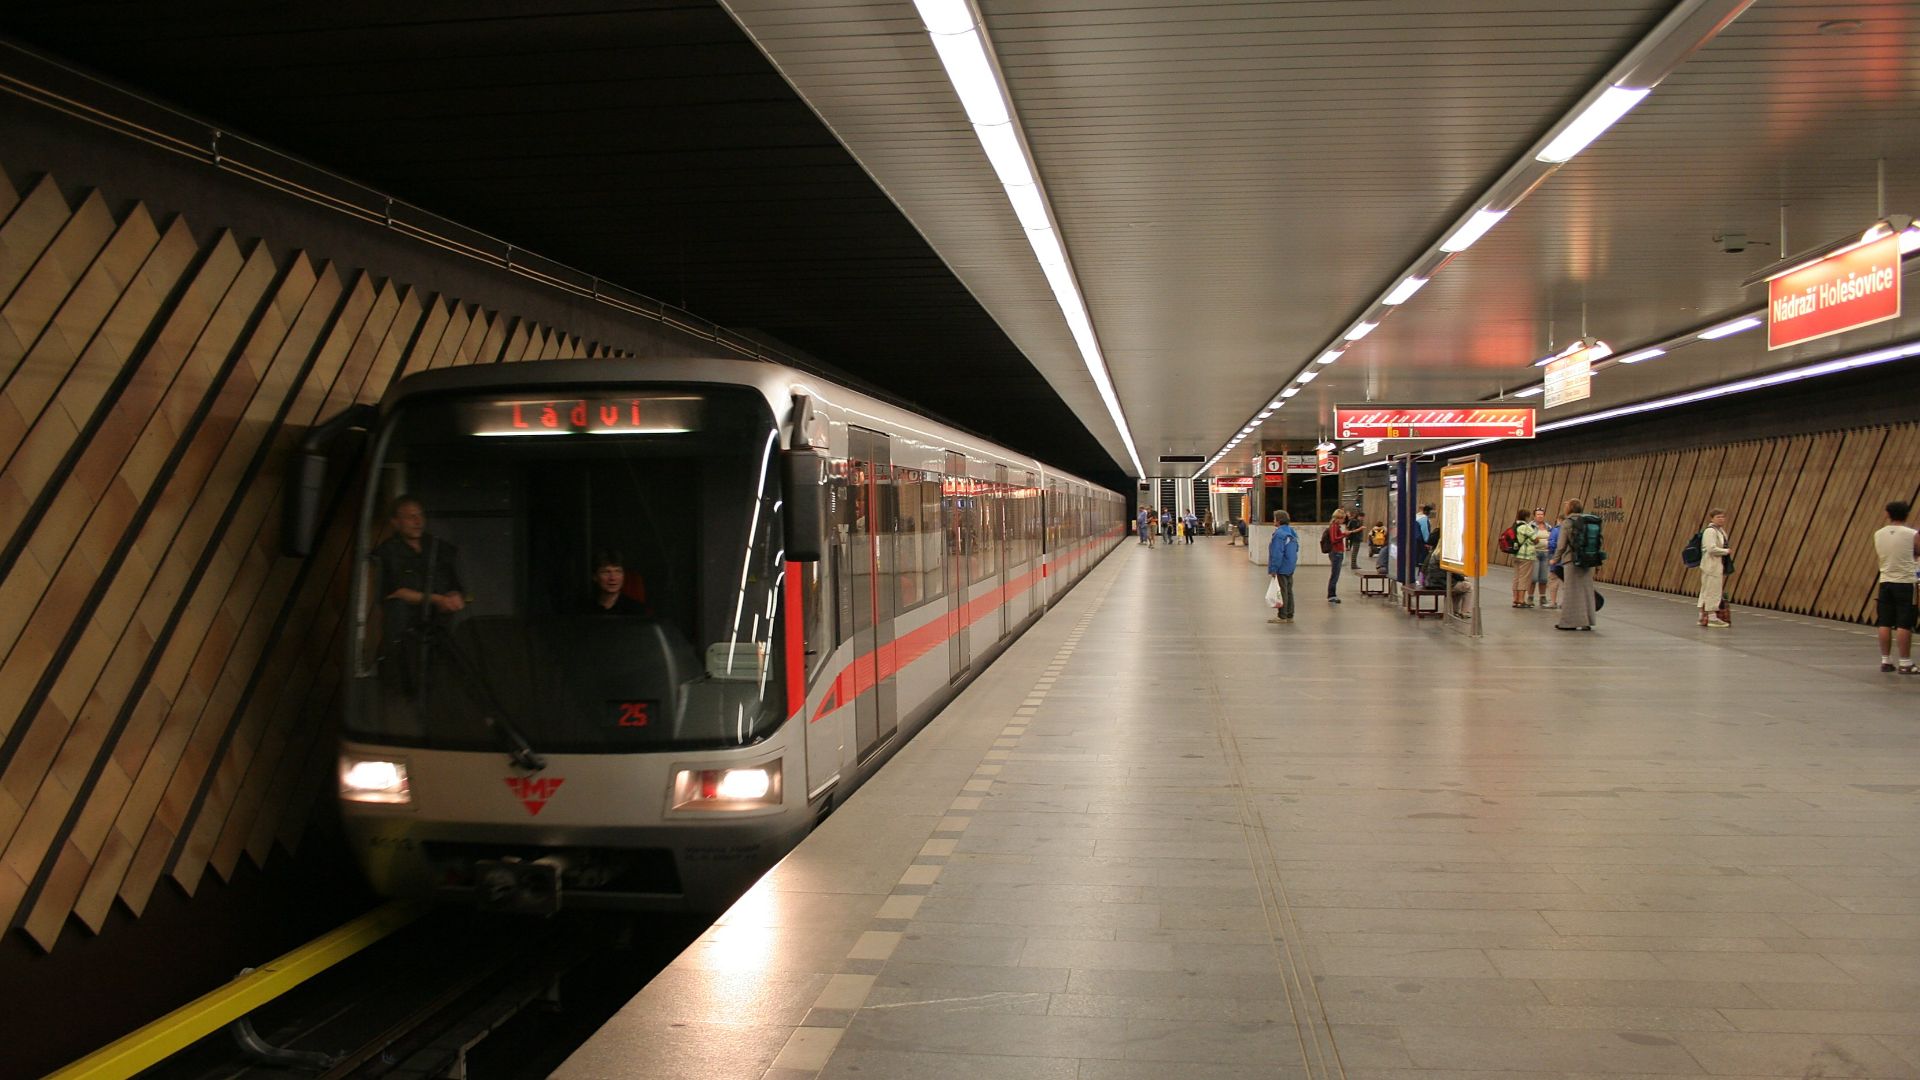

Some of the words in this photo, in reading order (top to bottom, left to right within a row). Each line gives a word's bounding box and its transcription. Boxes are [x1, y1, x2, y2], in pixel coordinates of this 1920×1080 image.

[1772, 285, 1817, 323] Nádraží
[1819, 266, 1893, 309] Holešovice
[618, 703, 648, 727] 25
